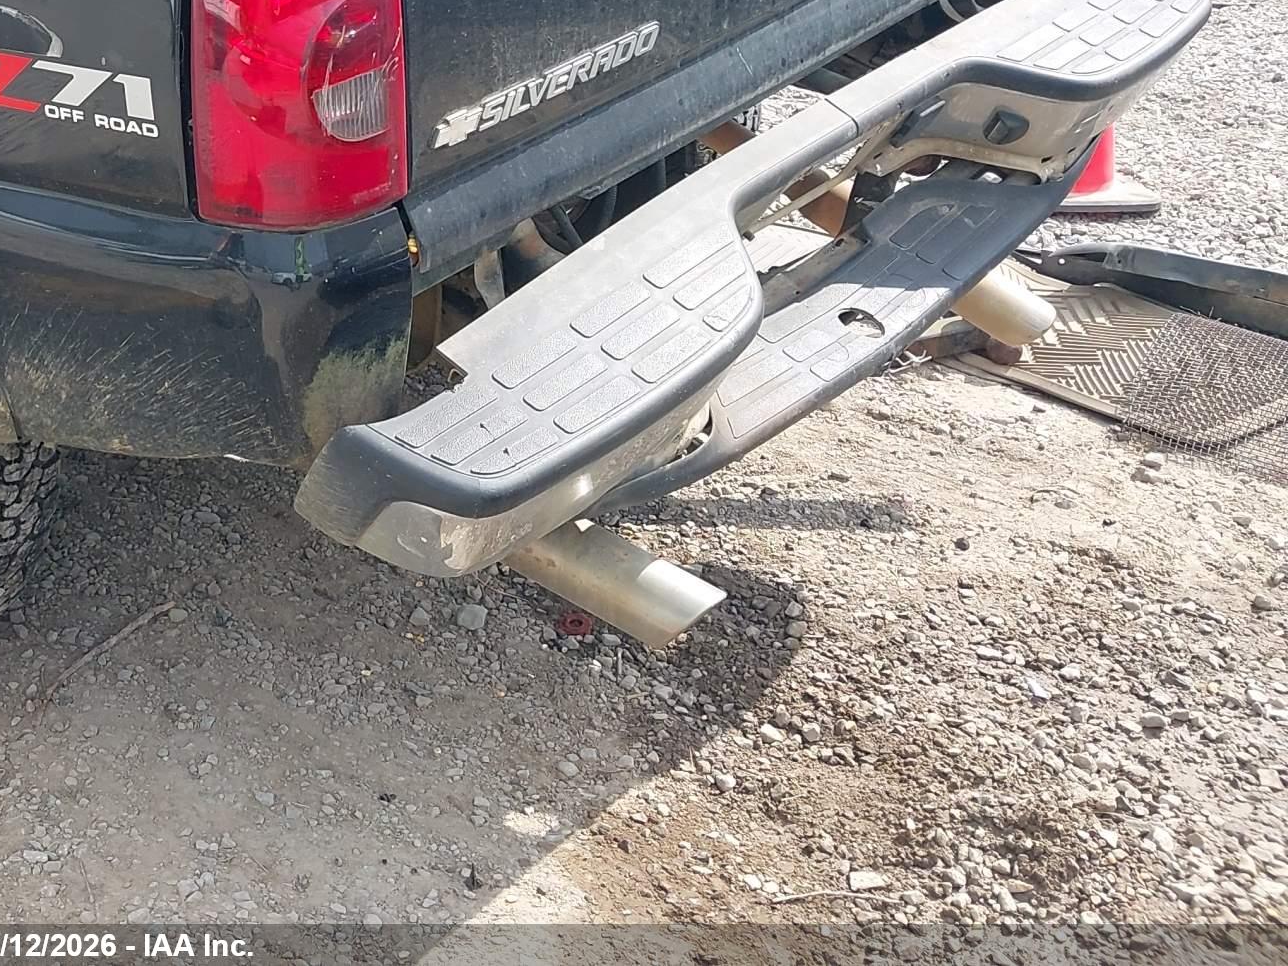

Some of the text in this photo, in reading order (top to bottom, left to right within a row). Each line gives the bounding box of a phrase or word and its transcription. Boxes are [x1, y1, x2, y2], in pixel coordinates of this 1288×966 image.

[478, 20, 660, 132] SILVERADO
[44, 105, 159, 138] OFF ROAD
